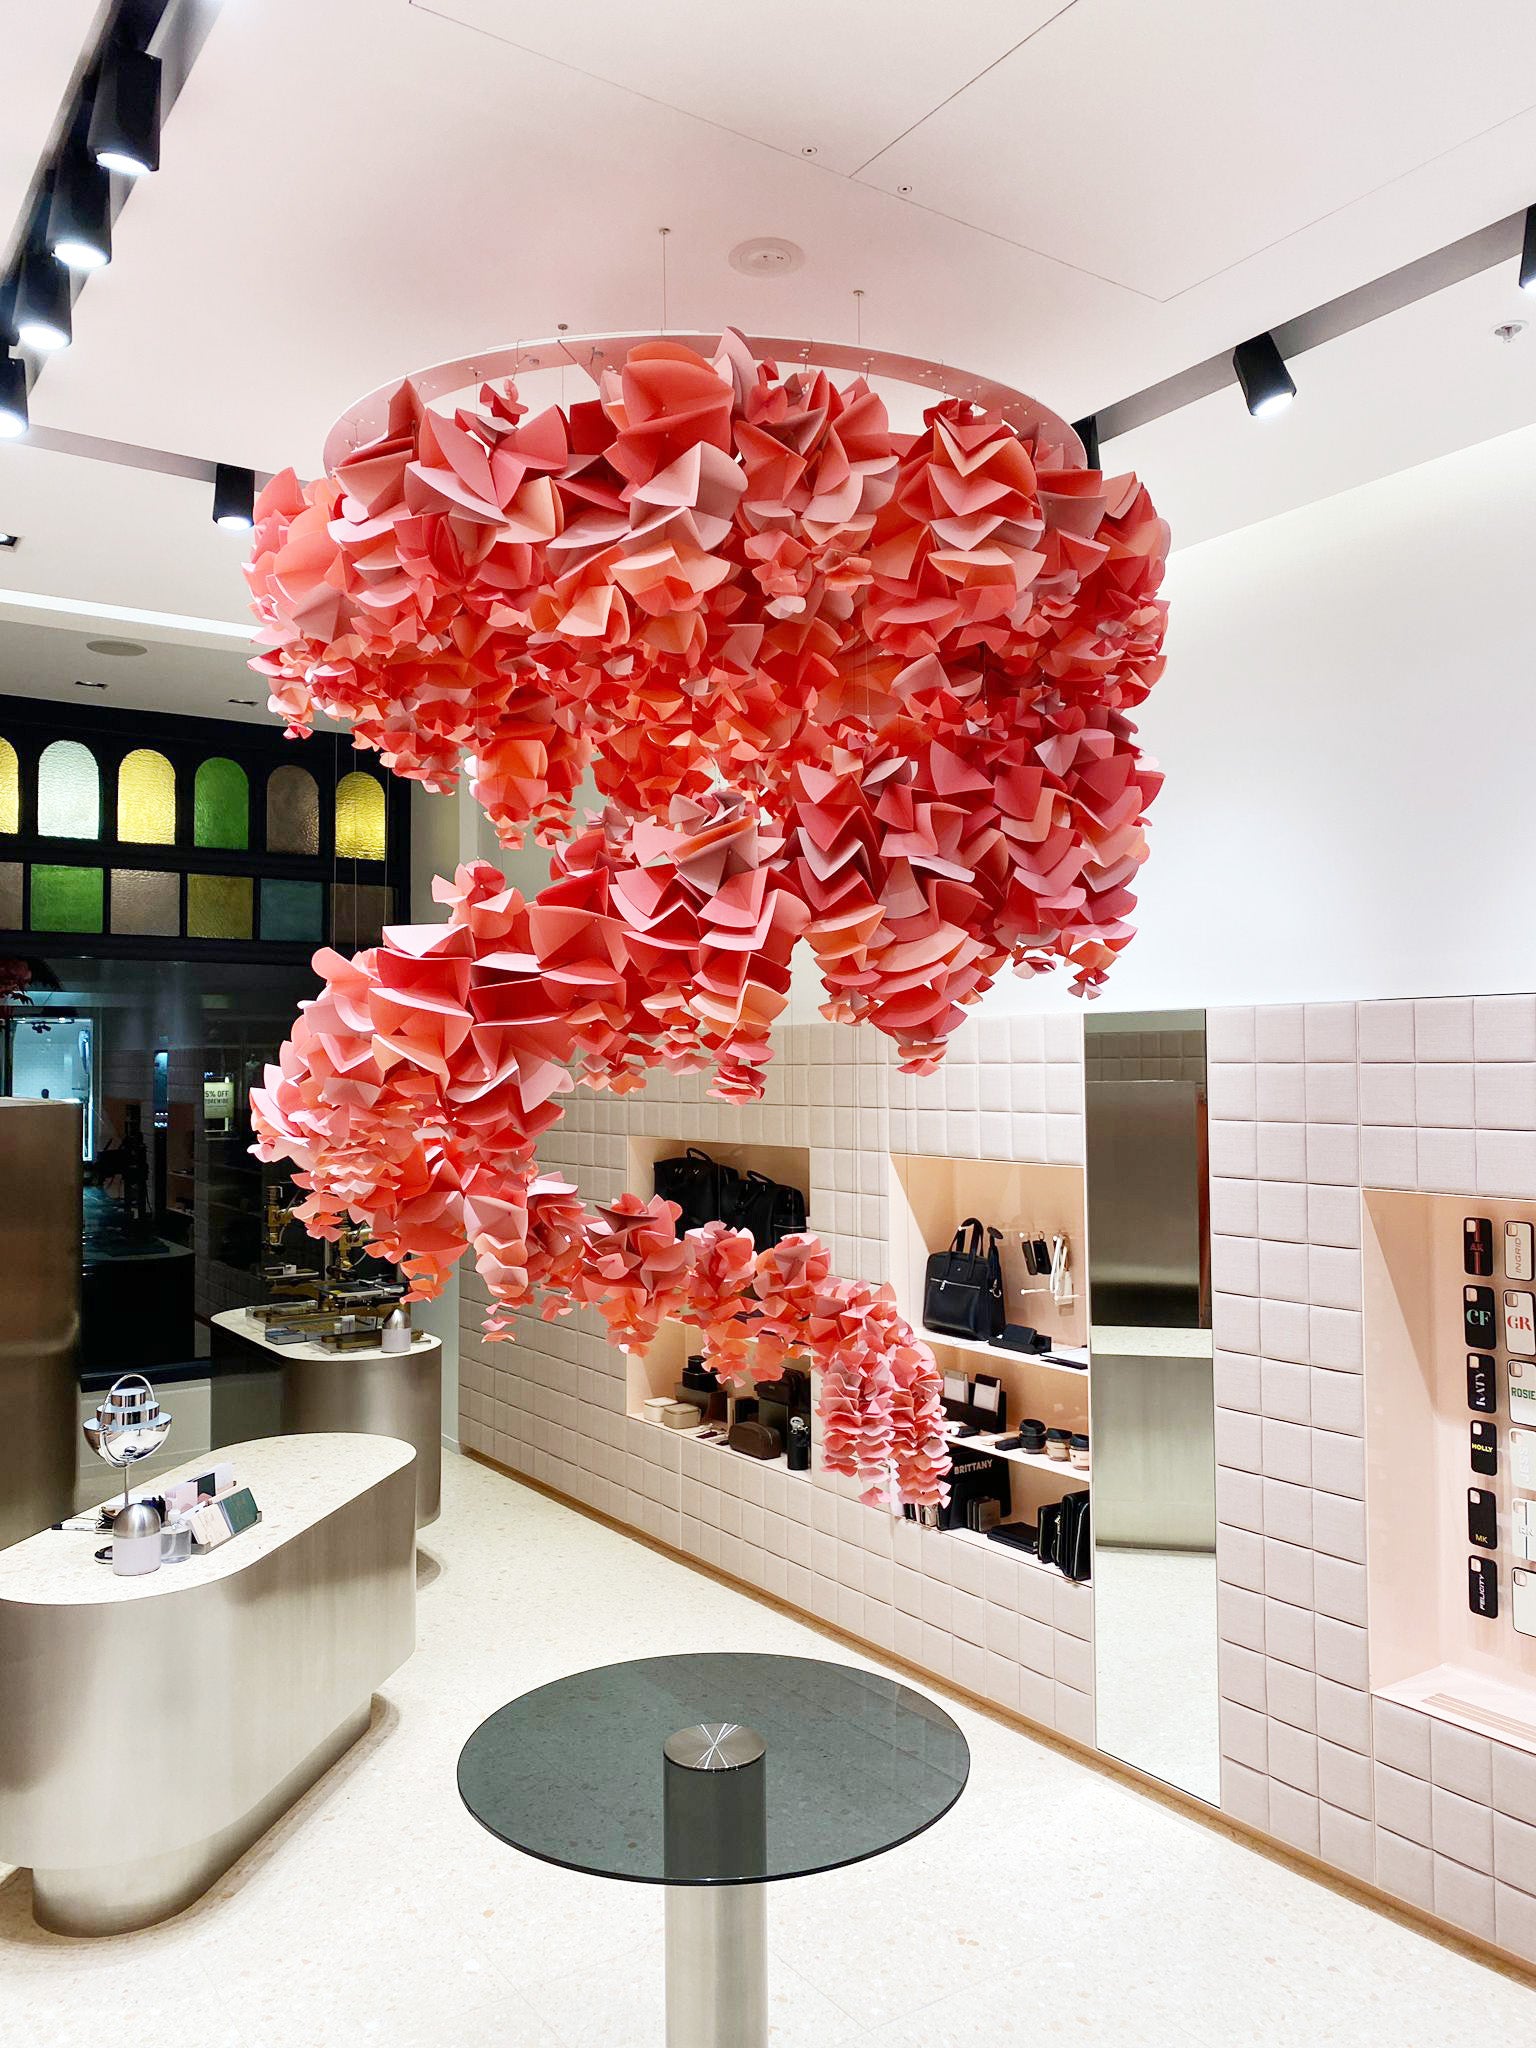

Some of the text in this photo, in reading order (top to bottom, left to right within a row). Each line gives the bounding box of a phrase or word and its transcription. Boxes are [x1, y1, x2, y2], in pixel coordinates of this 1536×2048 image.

[217, 1090, 229, 1098] OFF
[1514, 1237, 1522, 1274] INGRID
[1466, 1309, 1491, 1326] CF
[1507, 1315, 1532, 1331] GR
[1475, 1372, 1486, 1407] KATY
[1511, 1386, 1536, 1401] ROSIE
[1471, 1442, 1494, 1453] HOLLY
[954, 1459, 993, 1475] BRITTANY
[1475, 1533, 1489, 1544] MK
